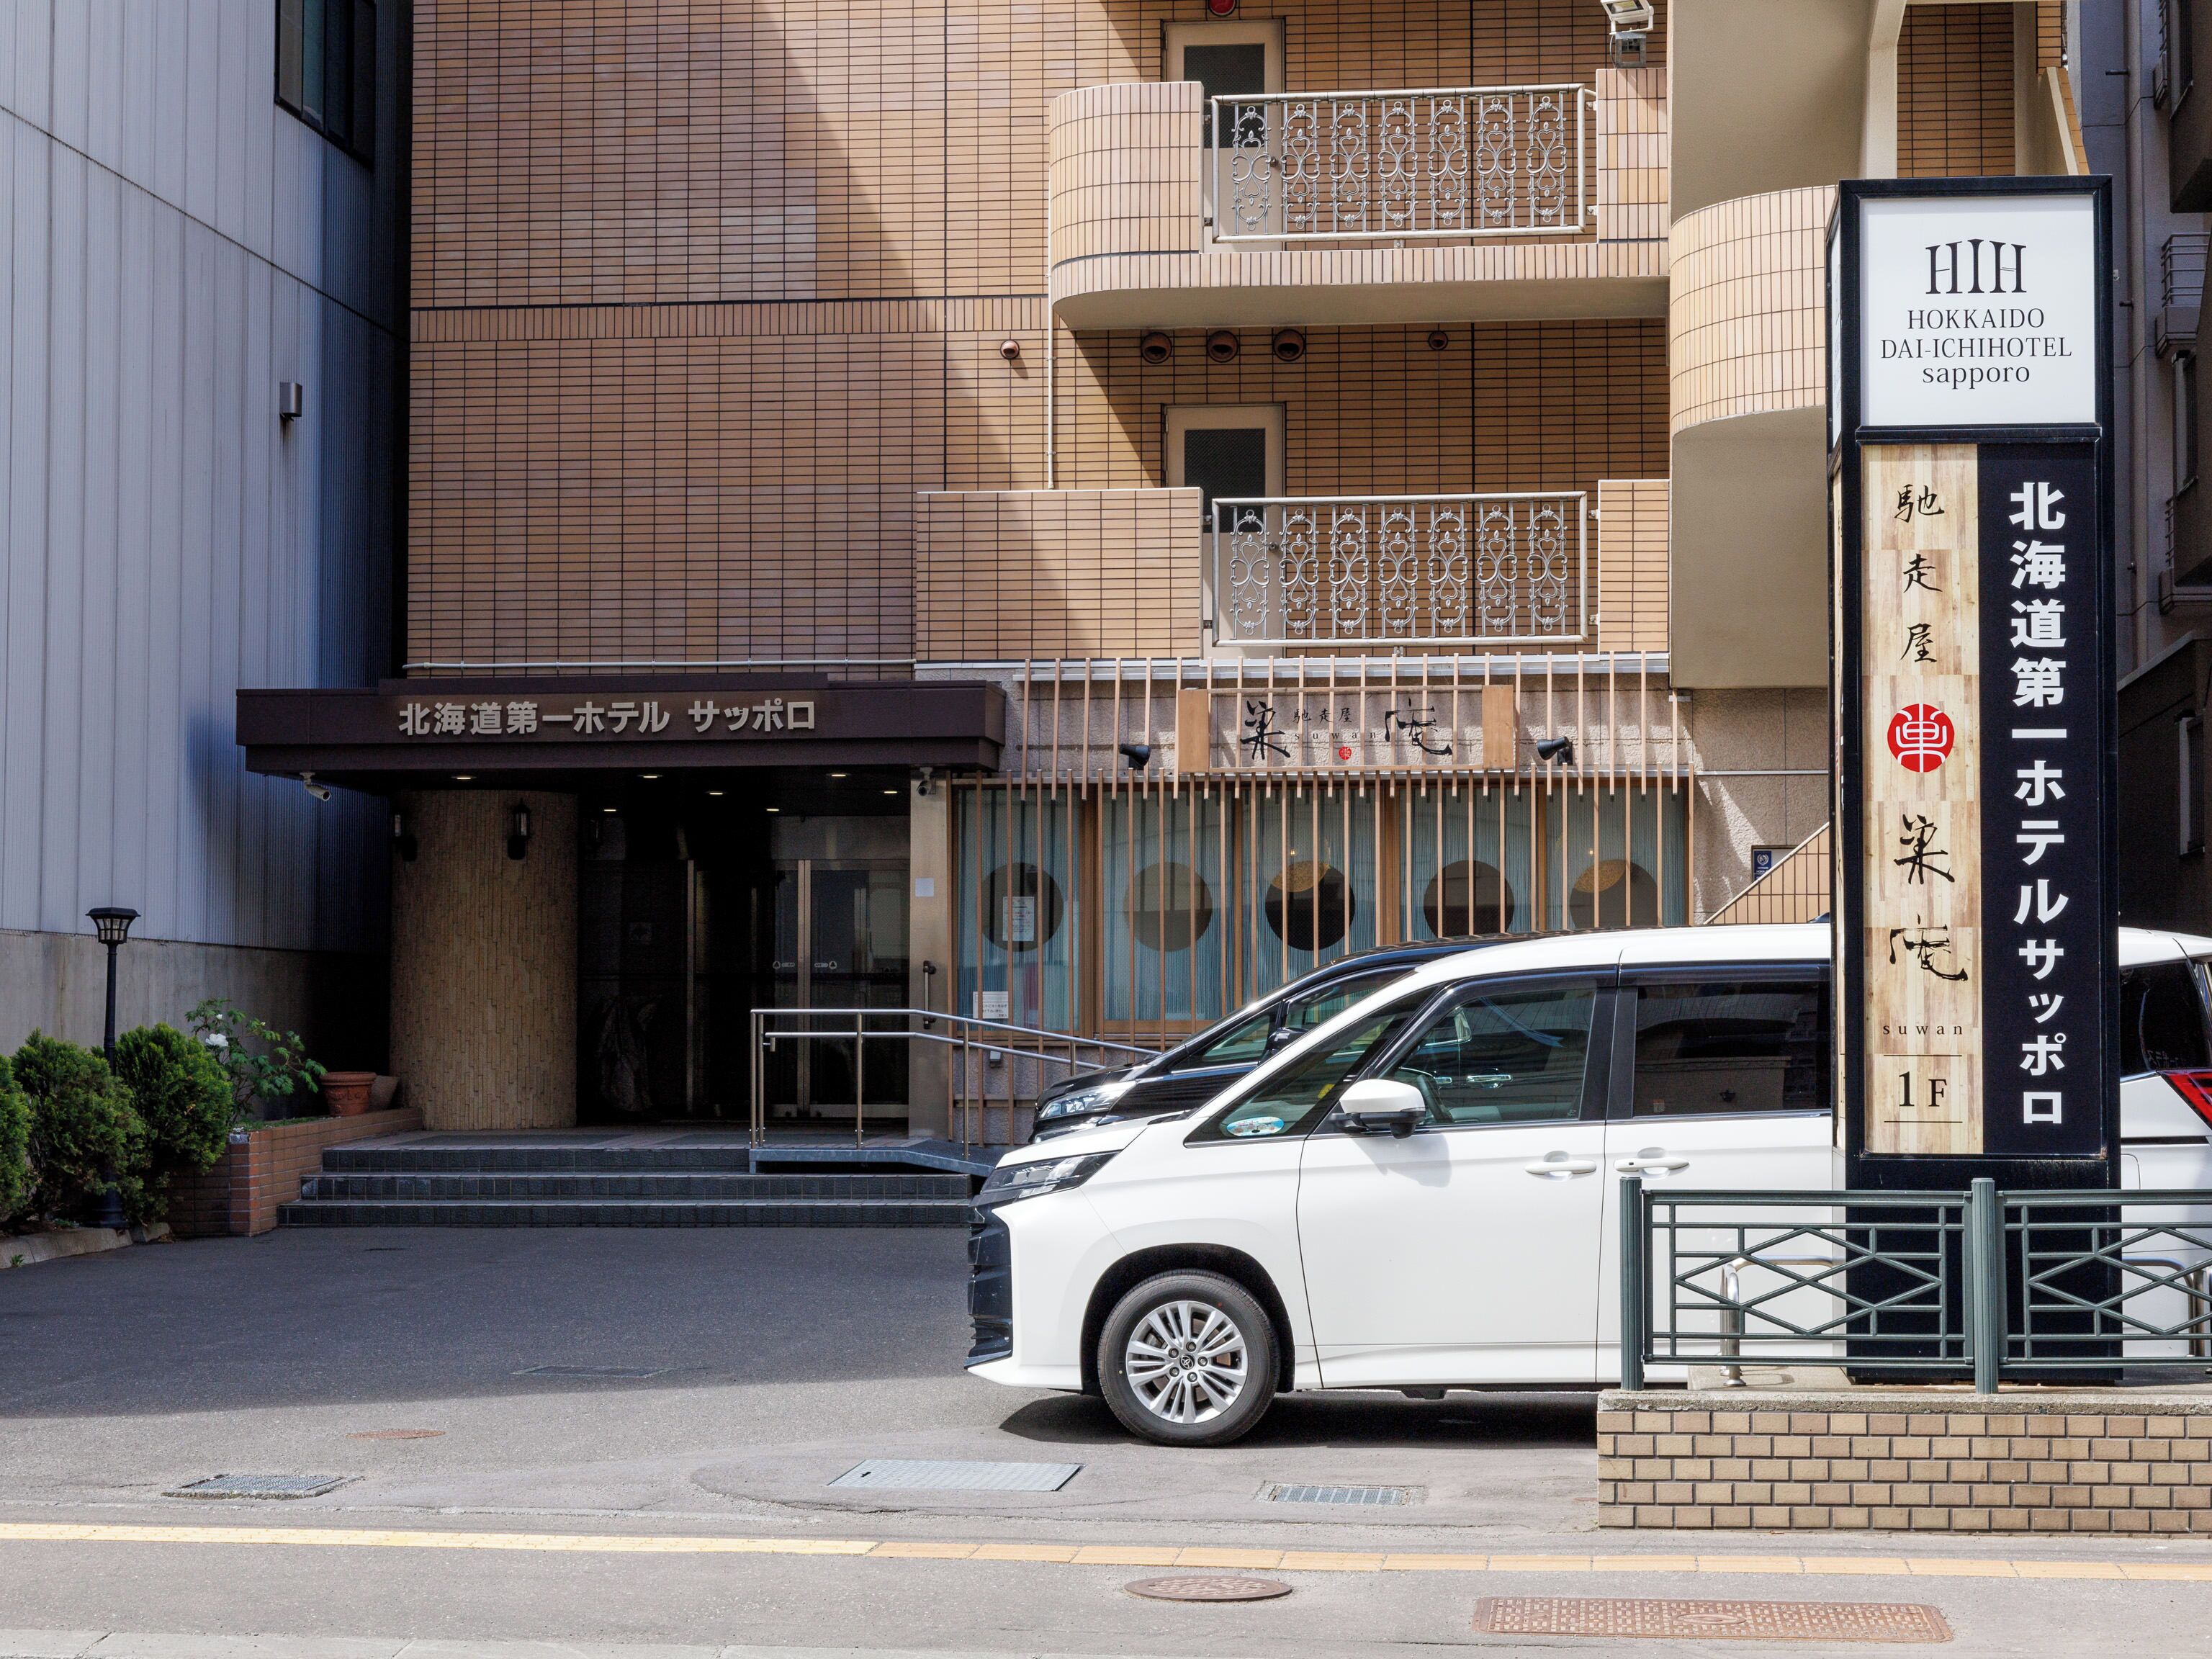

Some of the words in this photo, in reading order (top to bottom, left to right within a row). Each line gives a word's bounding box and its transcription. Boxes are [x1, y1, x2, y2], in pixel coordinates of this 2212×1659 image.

[1907, 307, 2045, 330] HOKKAIDO
[1881, 336, 2072, 359] DAI-ICHIHOTEL
[1923, 365, 2031, 390] sapporo
[1894, 484, 1946, 663] 馳走屋
[398, 701, 670, 736] 北海道第一ホテル
[688, 697, 816, 732] サッポロ
[1292, 707, 1352, 724] 馳走屋
[1295, 732, 1376, 741] suwan
[2008, 481, 2069, 1125] 北海道第一ホテルサッポロ
[1882, 1022, 1964, 1036] suwan
[1898, 1071, 1948, 1107] 1F
